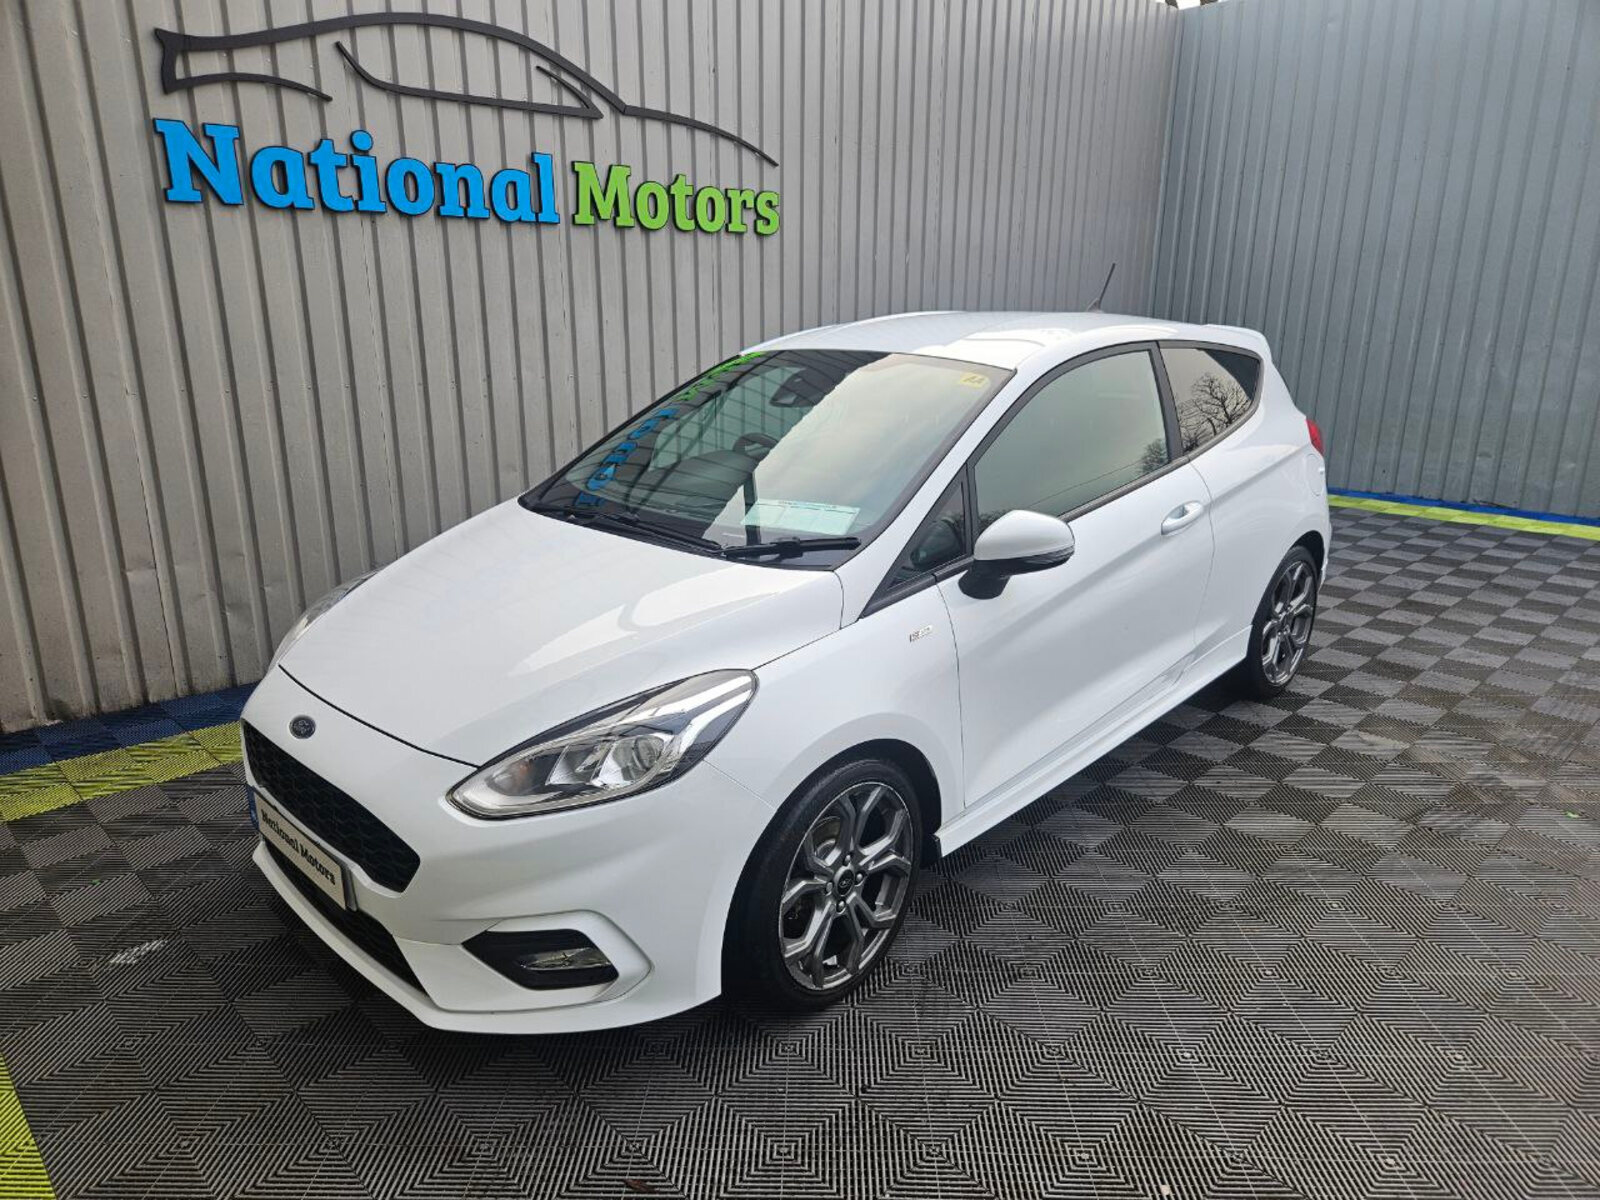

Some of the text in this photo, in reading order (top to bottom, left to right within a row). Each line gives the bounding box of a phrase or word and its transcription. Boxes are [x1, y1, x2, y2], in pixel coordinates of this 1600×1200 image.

[153, 118, 780, 236] National Motors
[261, 809, 336, 885] National Motors
